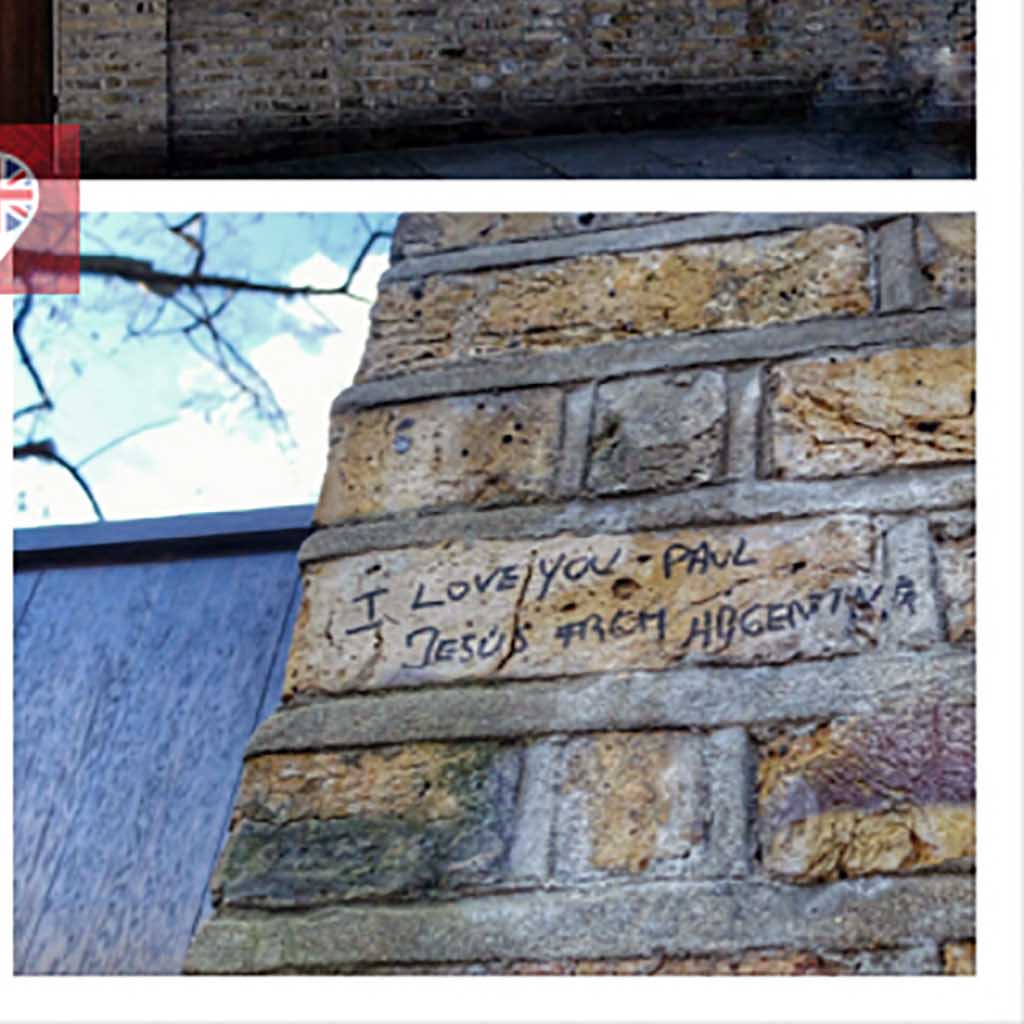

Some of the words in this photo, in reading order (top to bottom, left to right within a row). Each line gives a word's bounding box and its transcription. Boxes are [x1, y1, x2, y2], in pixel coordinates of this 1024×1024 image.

[344, 587, 389, 636] I
[411, 565, 520, 610] LOVE
[538, 548, 622, 601] YOU
[662, 538, 758, 579] PAUL
